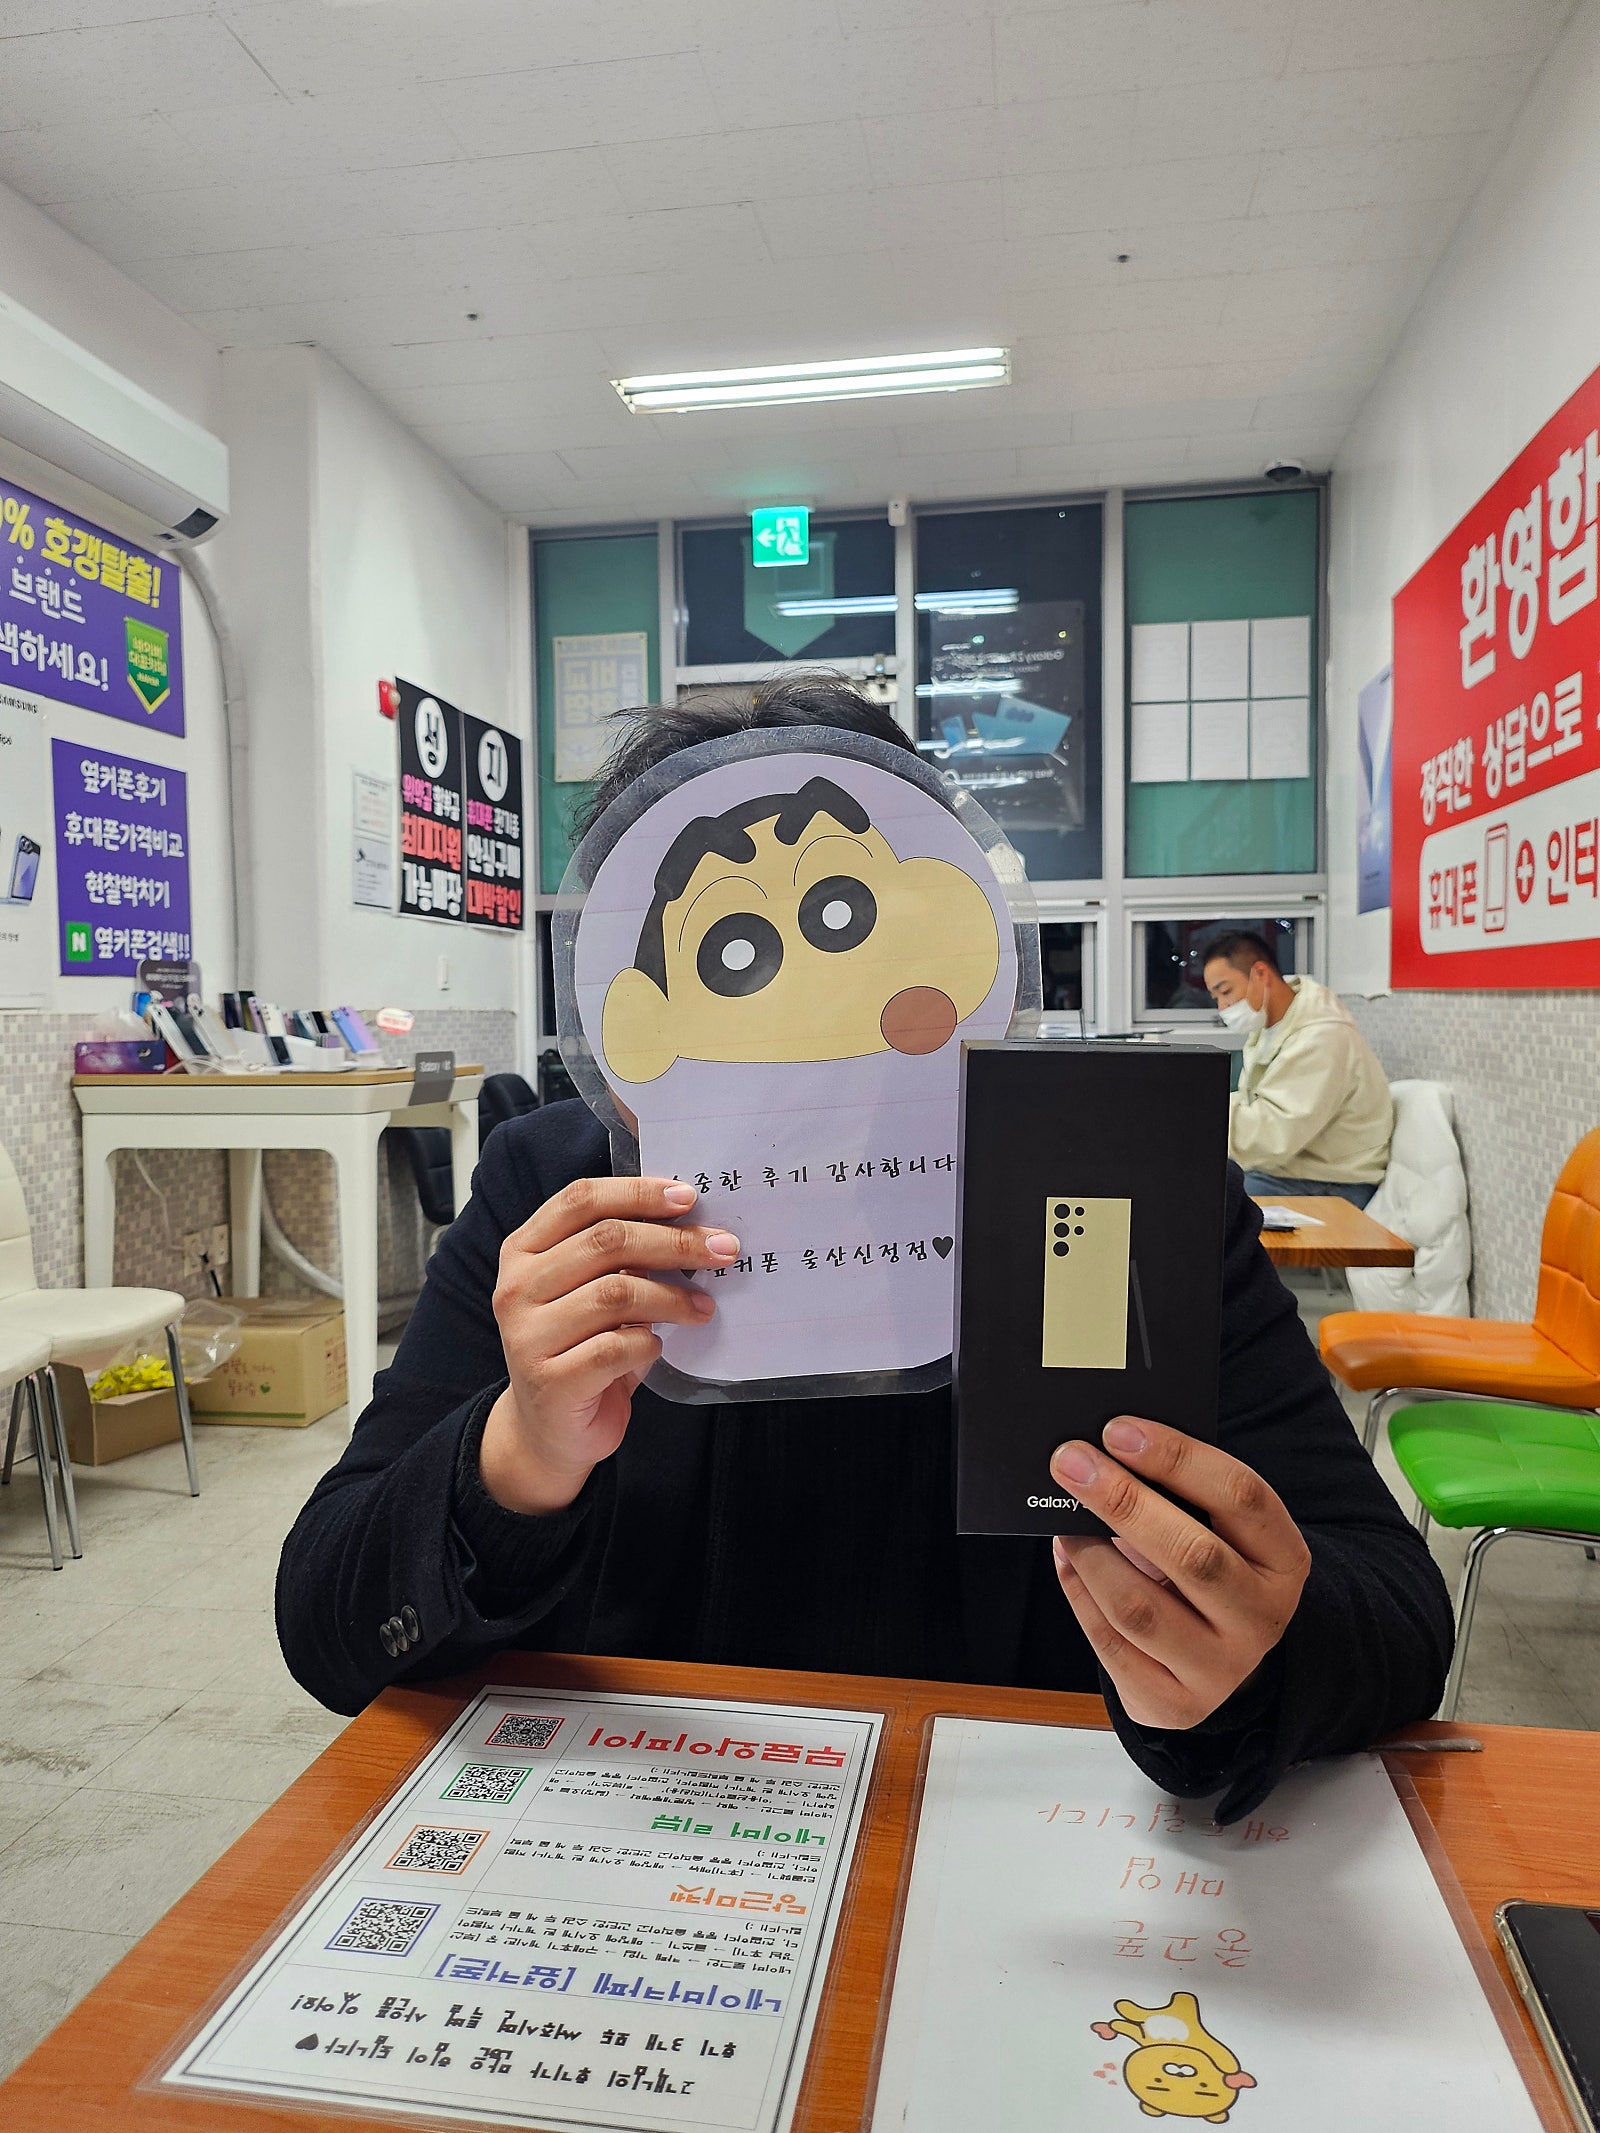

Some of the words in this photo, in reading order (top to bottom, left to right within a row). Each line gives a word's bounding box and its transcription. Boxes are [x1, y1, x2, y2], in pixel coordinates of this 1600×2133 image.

[41, 517, 162, 608] 호갱탈출!
[9, 567, 86, 624] 브랜드
[424, 711, 440, 766] 성
[486, 741, 501, 788] 지
[1420, 736, 1475, 827] 정직한
[1482, 669, 1583, 799] 상담으로
[80, 759, 167, 807] 옆커폰후기
[64, 811, 185, 858] 휴대폰가격비교
[467, 833, 521, 879] 안심구매
[402, 861, 463, 916] 가능매장
[1429, 860, 1477, 931] 휴대폰
[1547, 816, 1600, 906] 인터
[84, 870, 170, 909] 현찰박치기
[467, 878, 521, 925] 대박할인
[72, 931, 87, 952] N
[95, 926, 190, 961] 옆커폰검색!!
[672, 1170, 743, 1195] 중한
[761, 1165, 809, 1188] 후기
[825, 1153, 957, 1183] 감사합니다
[800, 1239, 928, 1270] 울산신정점
[1027, 1495, 1080, 1512] Galaxy
[586, 1727, 847, 1767] 무료와이파이
[650, 1813, 713, 1835] 리뷰
[729, 1821, 826, 1846] 네이버
[1119, 1855, 1223, 1897] 매입
[669, 1884, 807, 1915] 당근마켓
[449, 1930, 481, 1942] [부산
[484, 1934, 498, 1943] 중
[502, 1936, 540, 1948] 게시판
[546, 1940, 598, 1955] 구매후기
[1111, 1918, 1251, 1968] 중고폰
[621, 1949, 648, 1960] 가입
[654, 1952, 680, 1963] 카페
[705, 1957, 746, 1970] 로그인
[751, 1962, 791, 1974] 네이버
[433, 1952, 577, 1992] [옆커폰]
[289, 1991, 362, 2015] 있어요!
[591, 1972, 782, 2012] 네이버카페
[374, 1995, 428, 2023] 사은품
[443, 2003, 484, 2029] 특별
[495, 2009, 582, 2041] 써주시면
[599, 2028, 630, 2047] 모두
[324, 2034, 394, 2059] 됩니다
[405, 2041, 451, 2067] 힘이
[644, 2032, 684, 2052] 3개
[698, 2038, 737, 2059] 후기
[469, 2046, 514, 2074] 많은
[529, 2060, 592, 2084] 후기가
[605, 2064, 695, 2095] 고객님의
